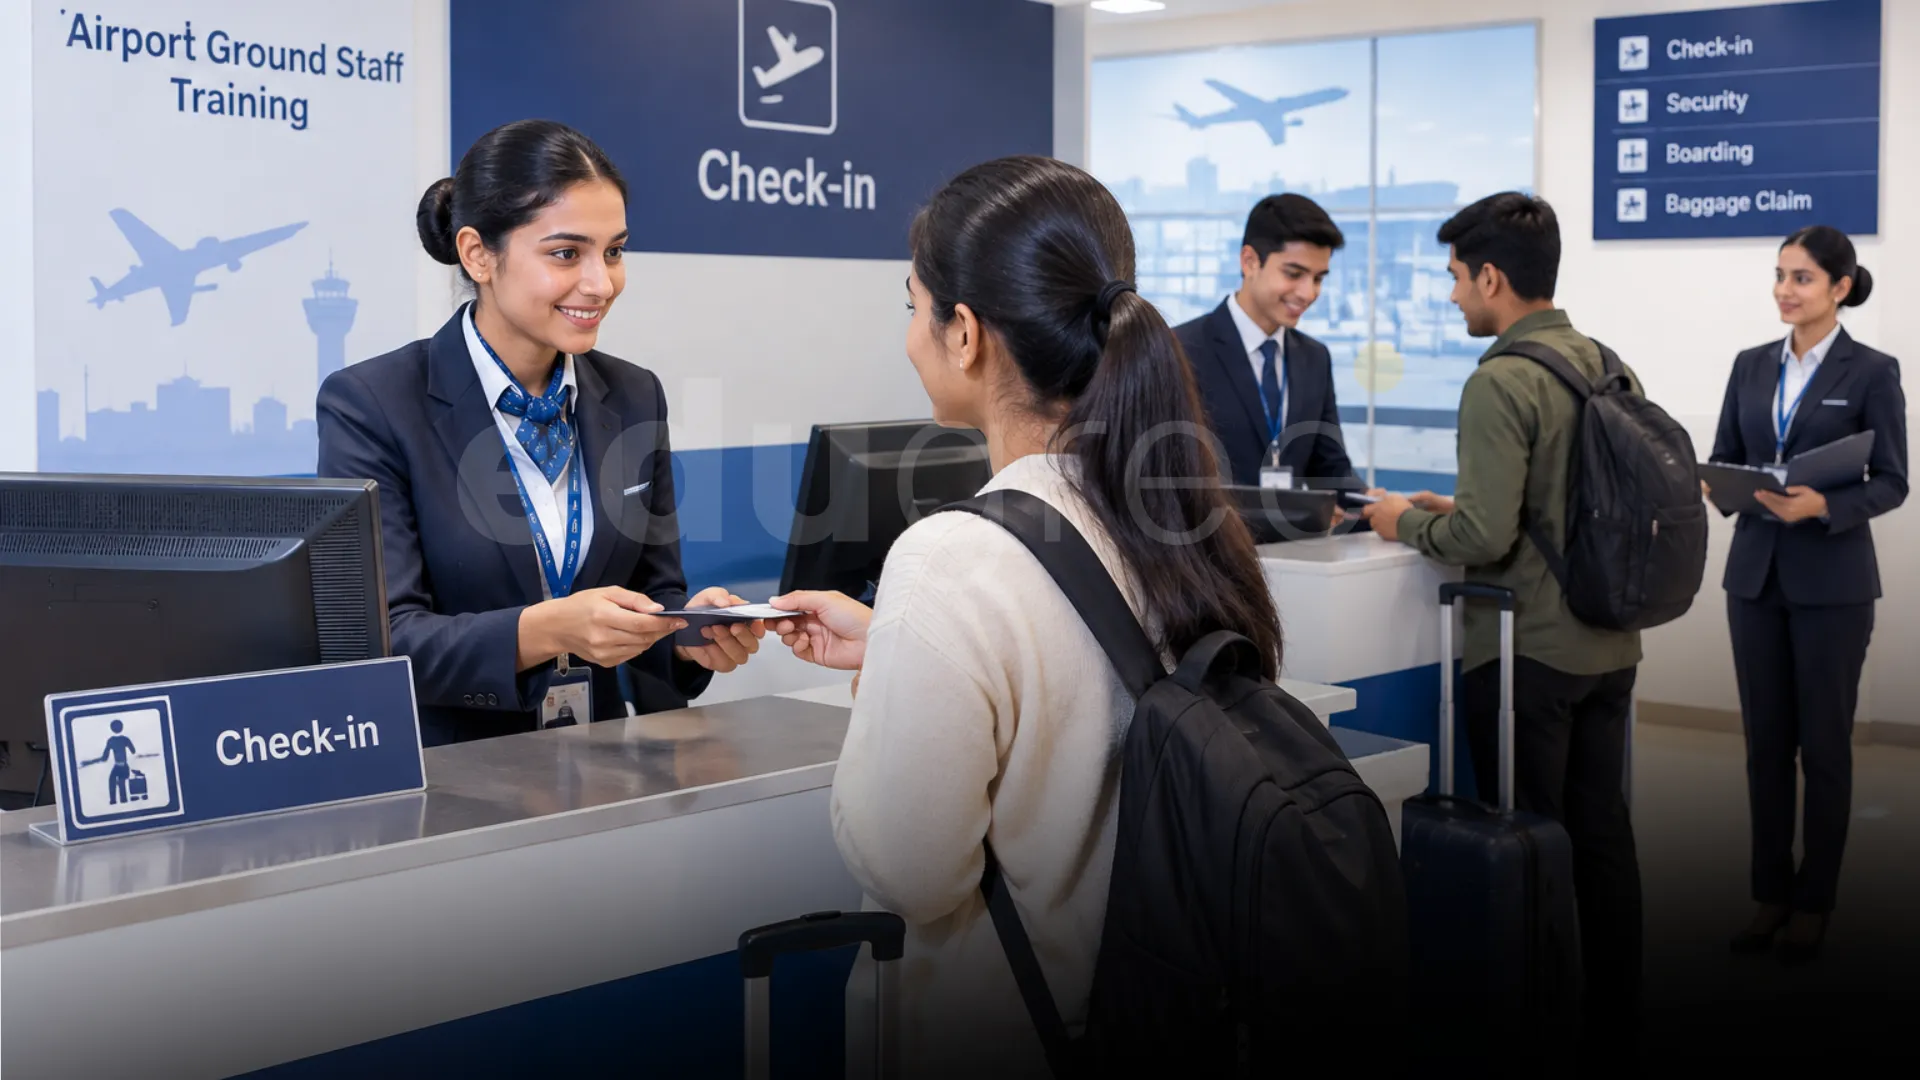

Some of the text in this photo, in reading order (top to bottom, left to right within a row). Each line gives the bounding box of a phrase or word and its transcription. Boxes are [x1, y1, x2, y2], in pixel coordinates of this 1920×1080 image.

[66, 13, 404, 83] Airport Ground Staff
[1666, 35, 1753, 60] Check-in
[170, 76, 308, 130] Training
[1666, 90, 1748, 114] Security
[1666, 141, 1754, 165] Boarding
[698, 148, 876, 210] Check-in
[1665, 190, 1812, 217] Baggage Claim
[215, 715, 380, 766] Check-in
